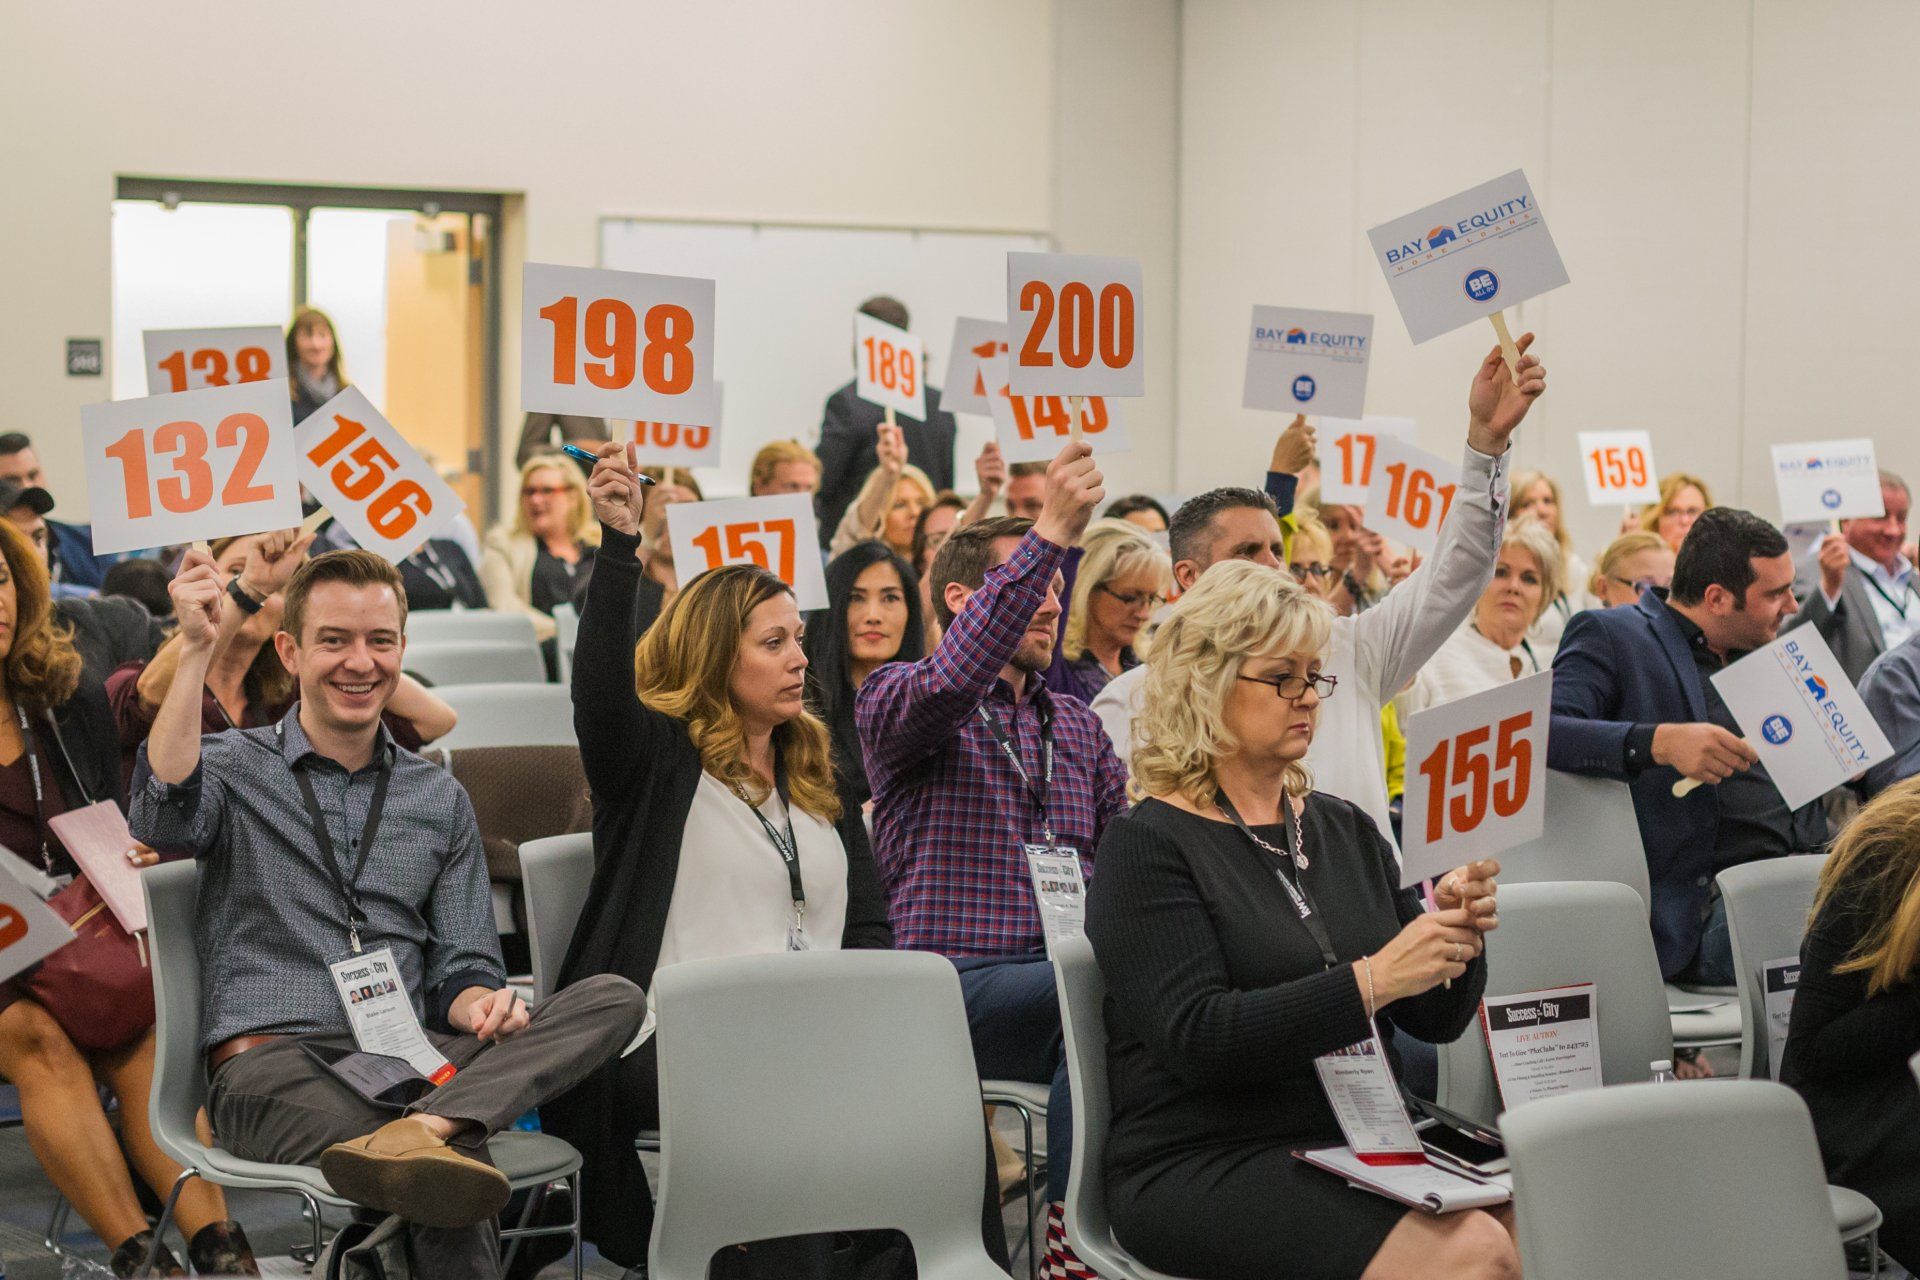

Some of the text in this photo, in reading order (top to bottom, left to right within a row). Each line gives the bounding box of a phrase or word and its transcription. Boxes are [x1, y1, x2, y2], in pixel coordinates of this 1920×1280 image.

[1385, 238, 1422, 264] BAY
[1456, 195, 1528, 234] EQUITY
[1468, 273, 1492, 292] BE
[540, 296, 694, 395] 198
[1019, 280, 1134, 369] 200
[1255, 327, 1366, 347] BAY EQUITY
[158, 346, 271, 393] 138
[863, 336, 916, 398] 189
[105, 413, 274, 519] 132
[306, 414, 433, 541] 156
[1334, 433, 1377, 487] 17
[1590, 446, 1648, 489] 159
[1384, 462, 1457, 534] 161
[692, 518, 796, 588] 157
[1784, 640, 1813, 673] BAY
[1824, 700, 1870, 762] EQUITY
[1419, 710, 1533, 844] 155
[340, 961, 388, 983] Success City
[1506, 1007, 1537, 1023] Success
[1542, 1002, 1560, 1018] City
